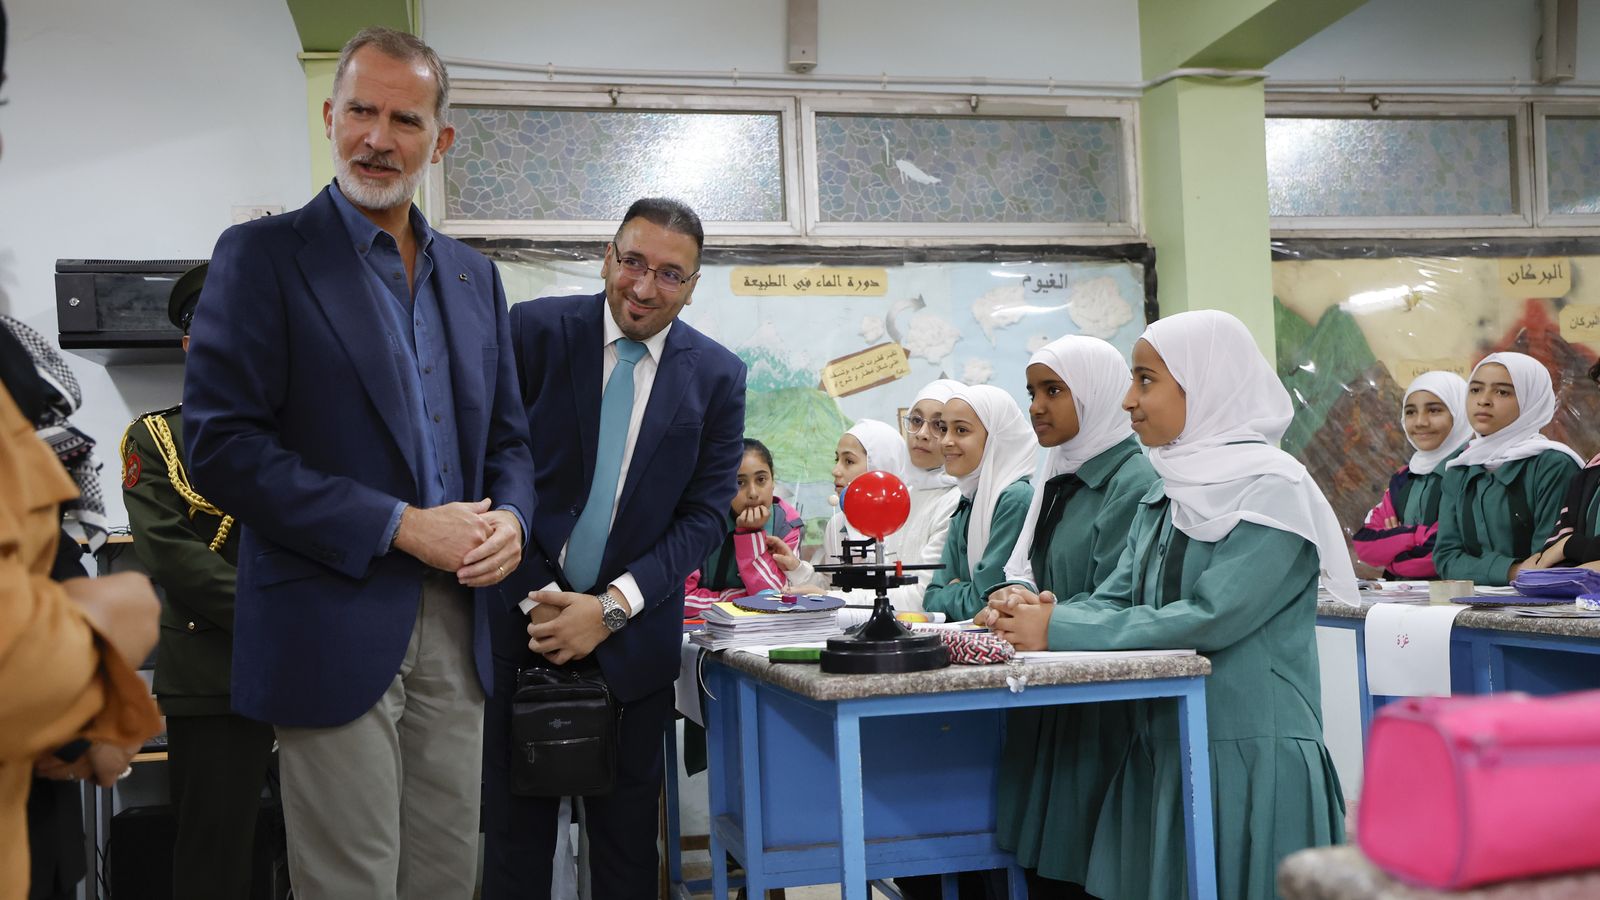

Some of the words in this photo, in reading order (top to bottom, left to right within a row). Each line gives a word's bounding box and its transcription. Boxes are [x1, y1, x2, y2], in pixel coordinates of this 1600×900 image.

[815, 274, 842, 287] الماء
[1507, 263, 1564, 285] البركان
[743, 274, 787, 291] الطبيعة
[793, 277, 812, 291] في
[847, 276, 880, 291] دورة
[1022, 273, 1068, 293] الغيوم
